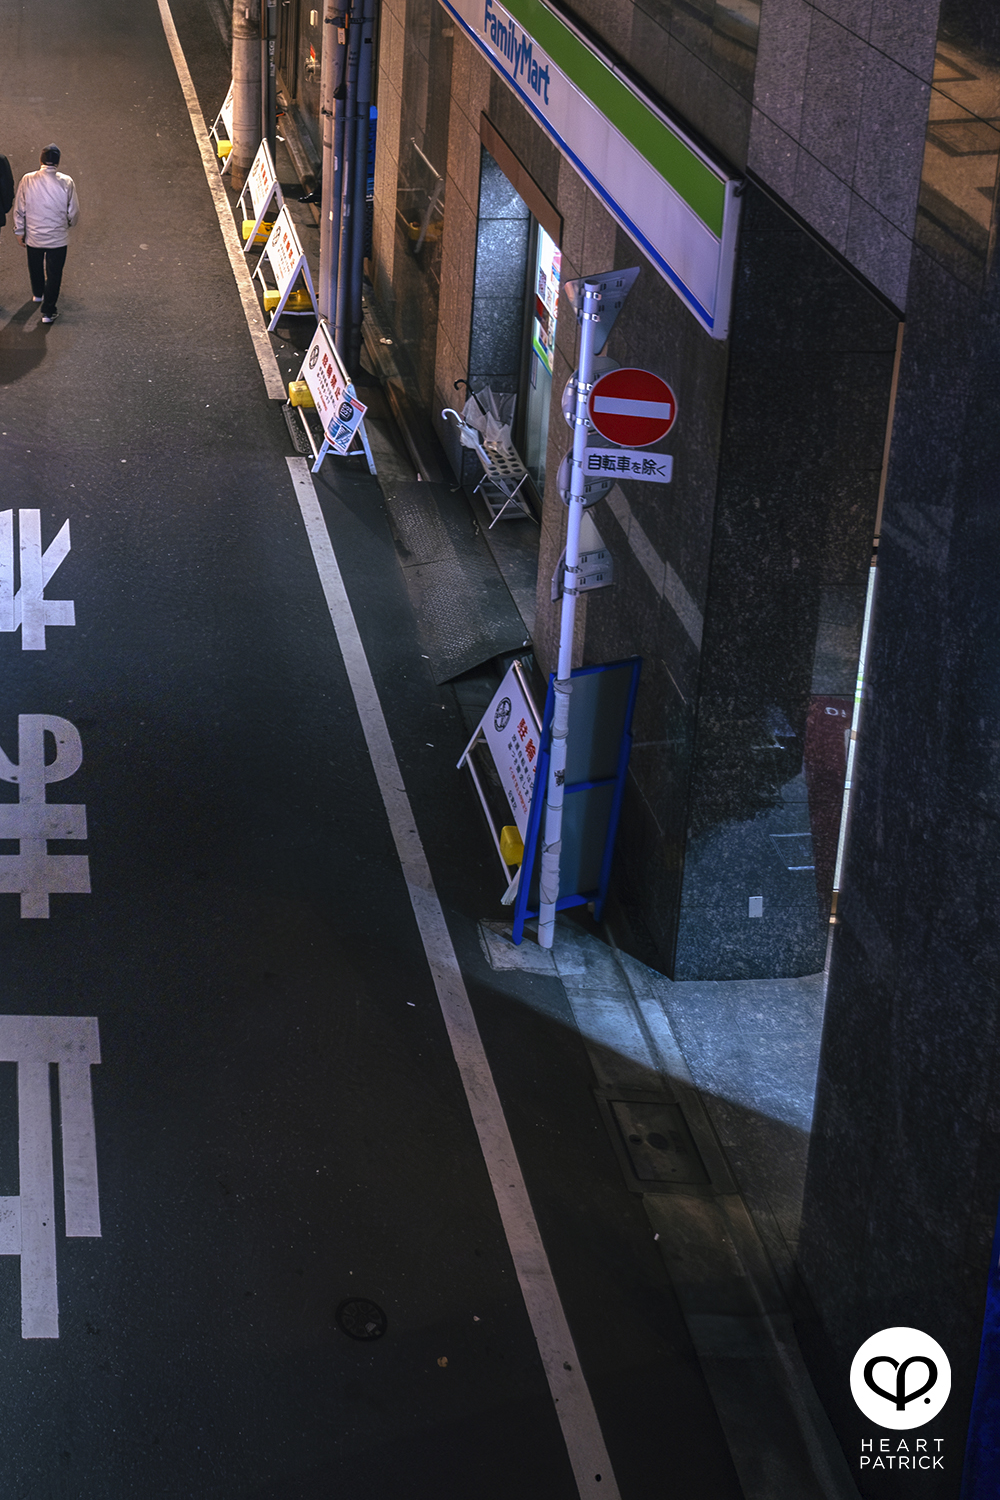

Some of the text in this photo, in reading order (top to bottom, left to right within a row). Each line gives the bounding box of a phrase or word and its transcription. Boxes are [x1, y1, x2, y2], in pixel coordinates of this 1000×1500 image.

[587, 453, 667, 477] 自転車を除く
[516, 717, 537, 774] 駐輪
